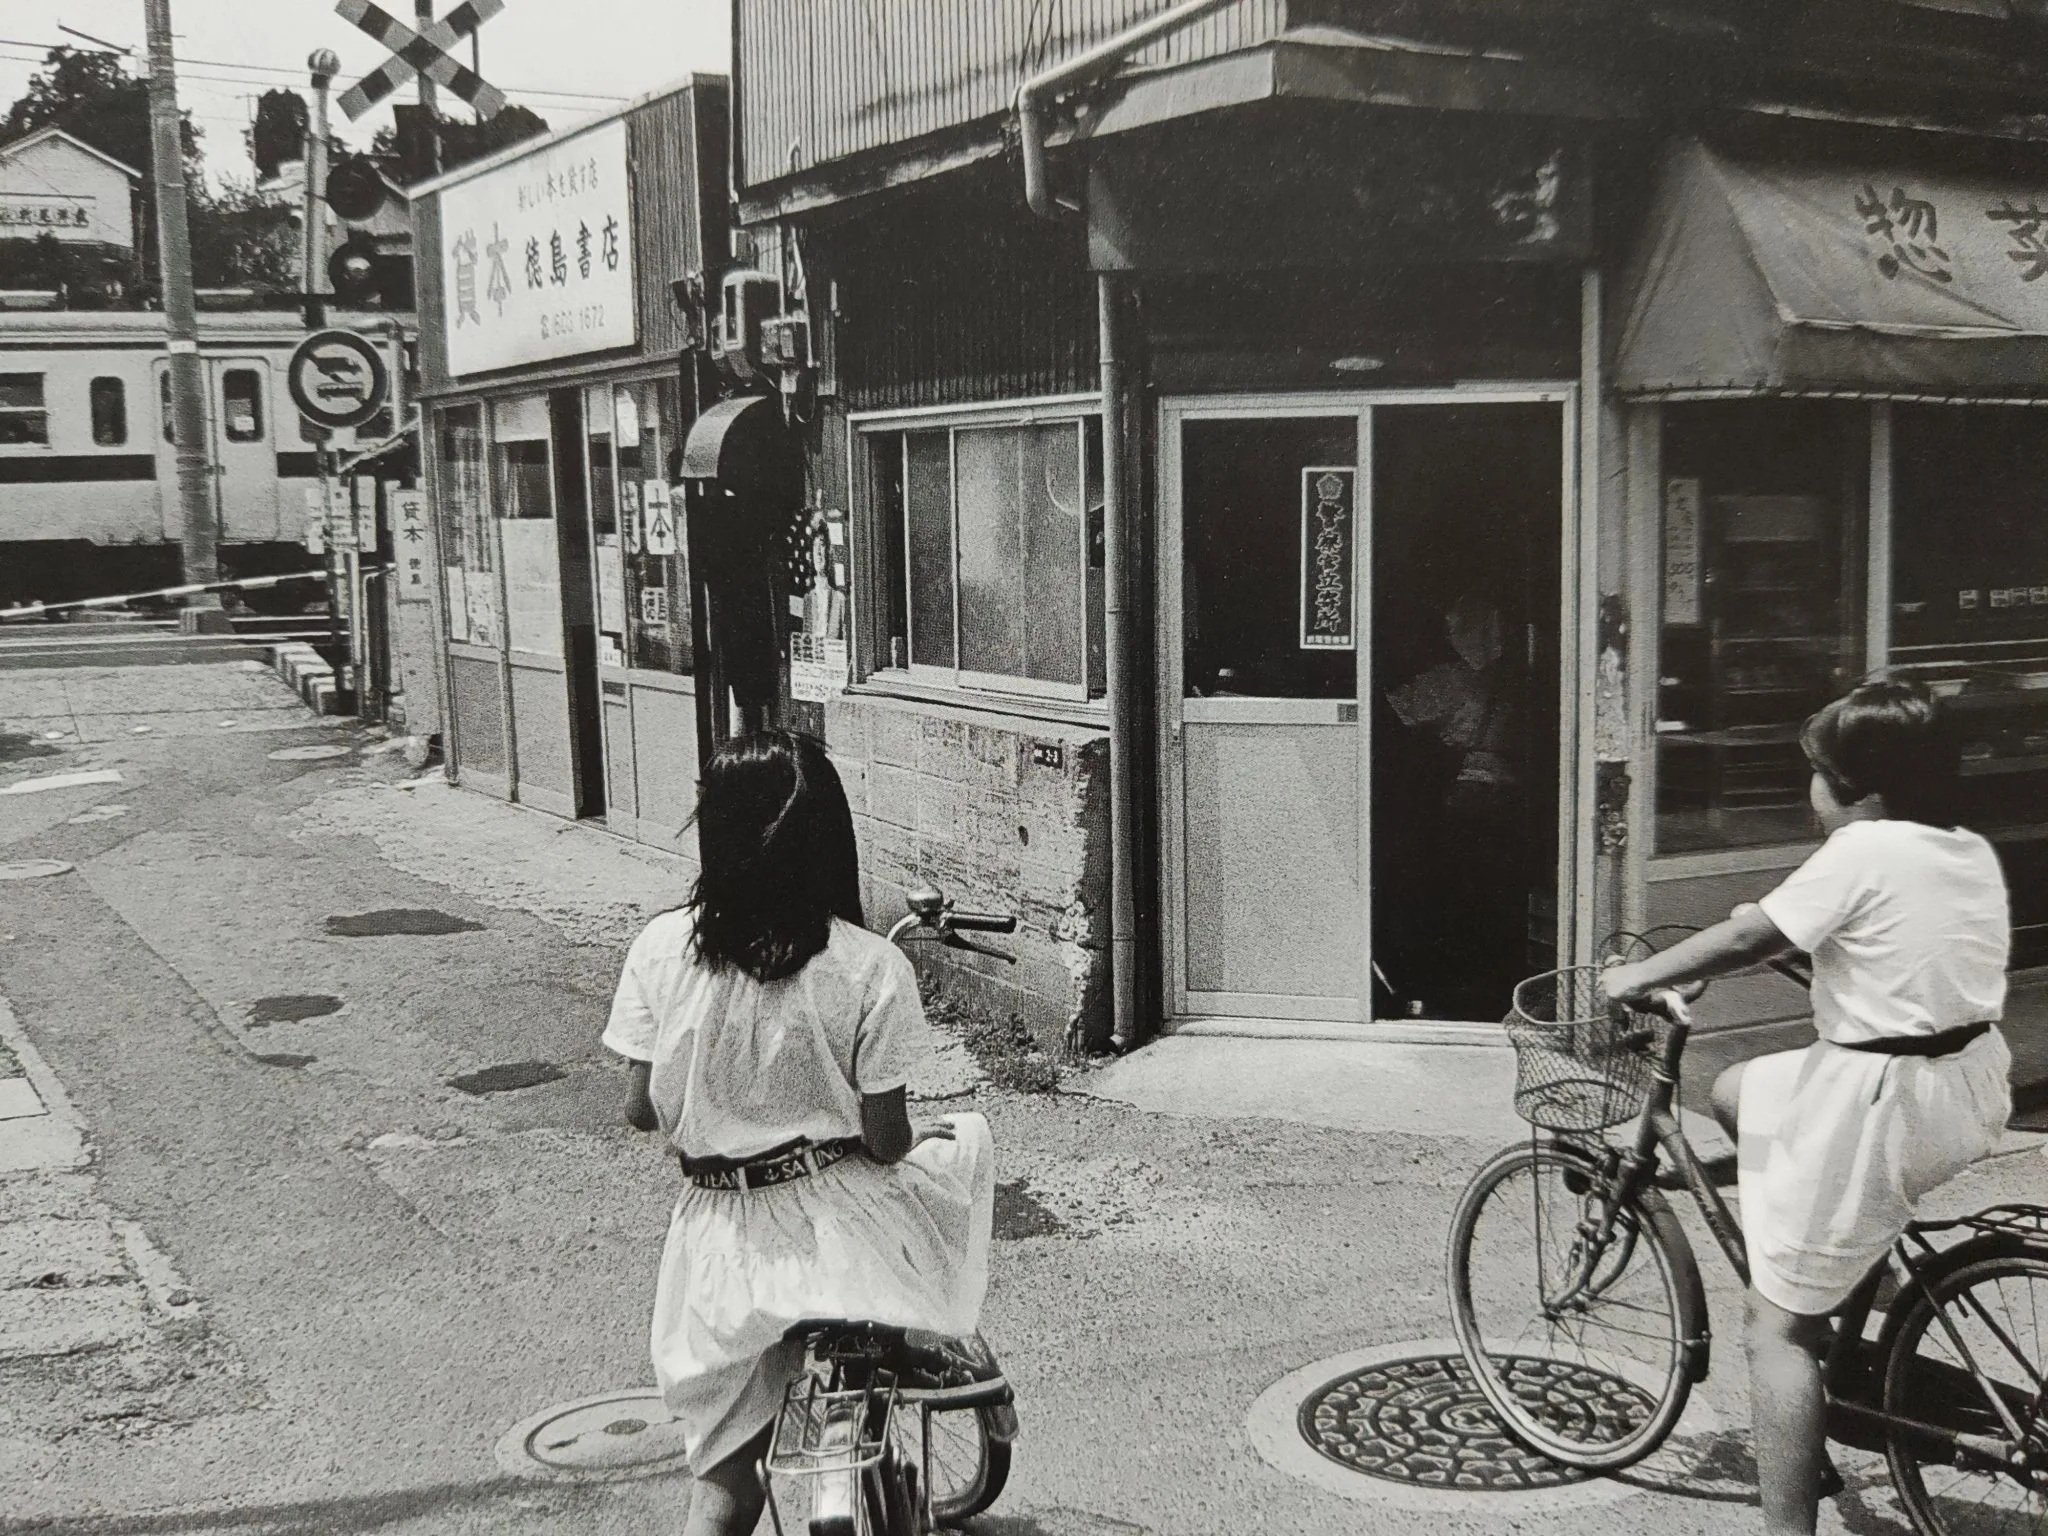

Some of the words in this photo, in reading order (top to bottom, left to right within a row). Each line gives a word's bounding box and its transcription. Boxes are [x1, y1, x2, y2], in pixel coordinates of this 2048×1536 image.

[451, 221, 513, 329] 貸本
[523, 214, 621, 290] 徳島書店
[401, 501, 425, 544] 貸本
